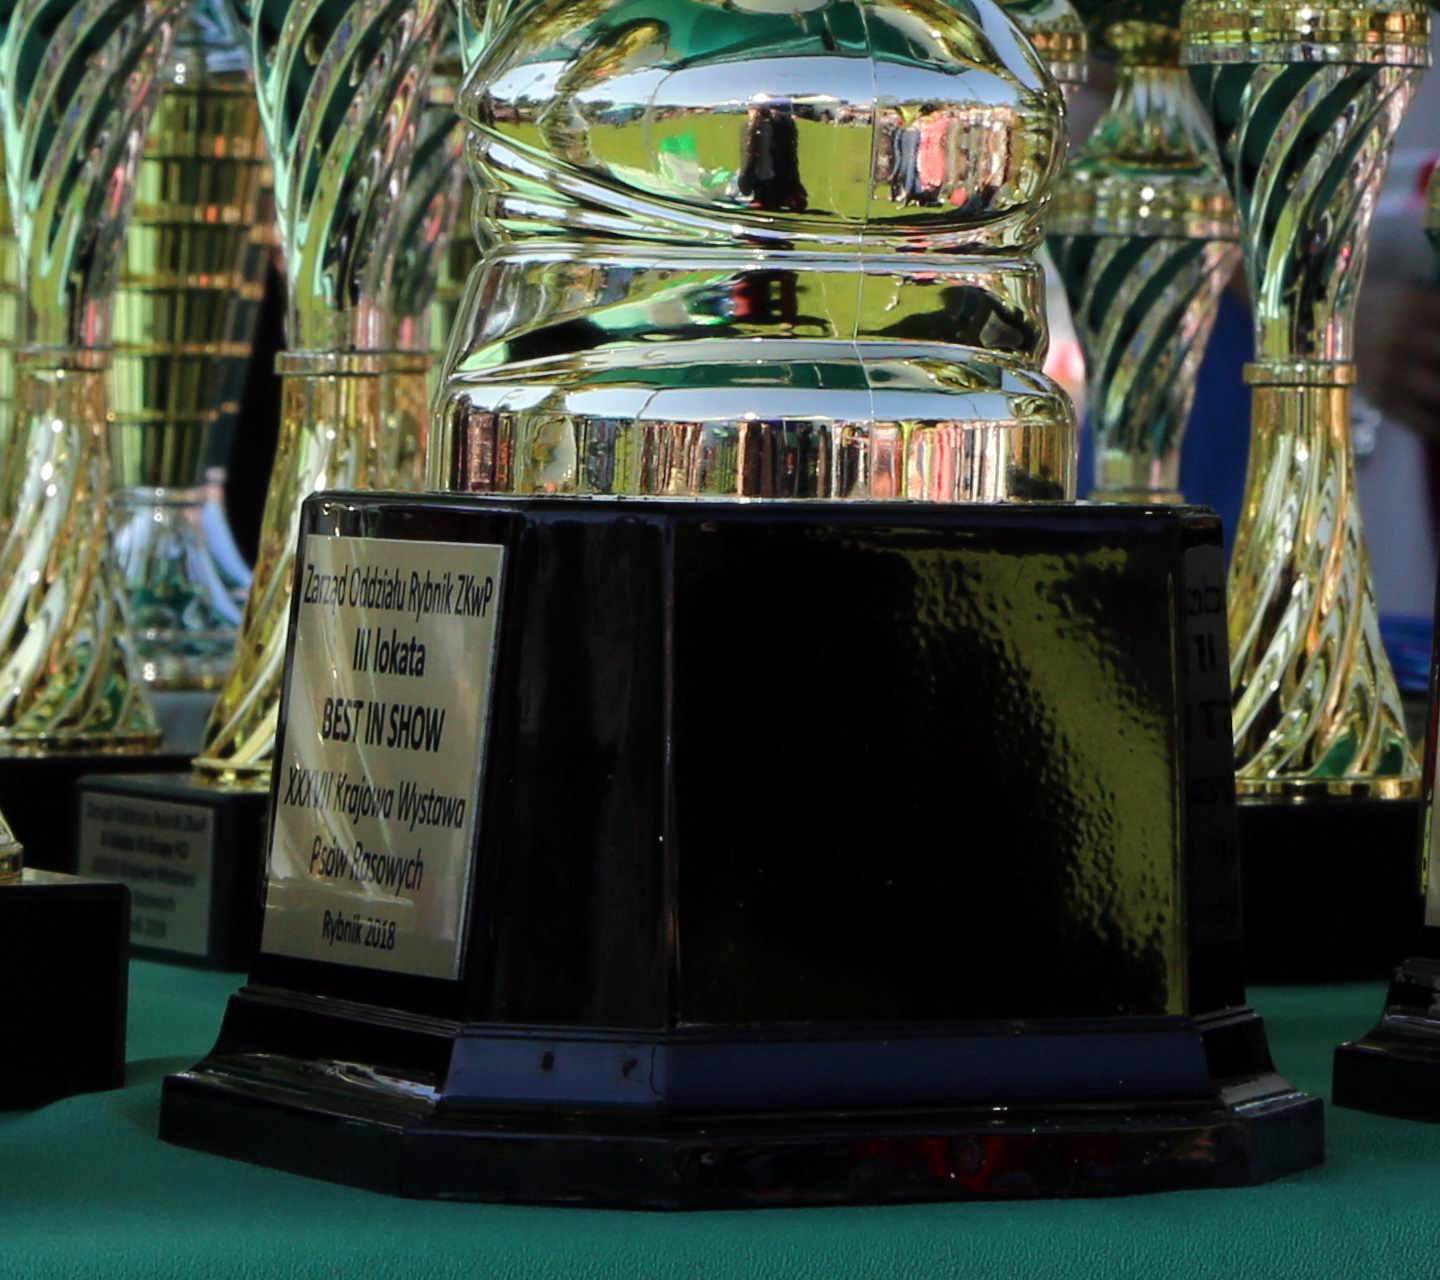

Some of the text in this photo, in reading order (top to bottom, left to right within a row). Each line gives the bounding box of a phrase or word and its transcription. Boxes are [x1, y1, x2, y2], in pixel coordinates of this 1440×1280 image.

[303, 564, 494, 622] Zarząd Oddziału Rybnik ZKwP
[352, 627, 426, 678] III lokata
[322, 697, 446, 753] BEST IN SHOW
[284, 766, 466, 833] XXXVII Krajowa Wystawa
[309, 835, 423, 897] Psów Rasowych
[321, 909, 397, 951] Rybnik 2018
